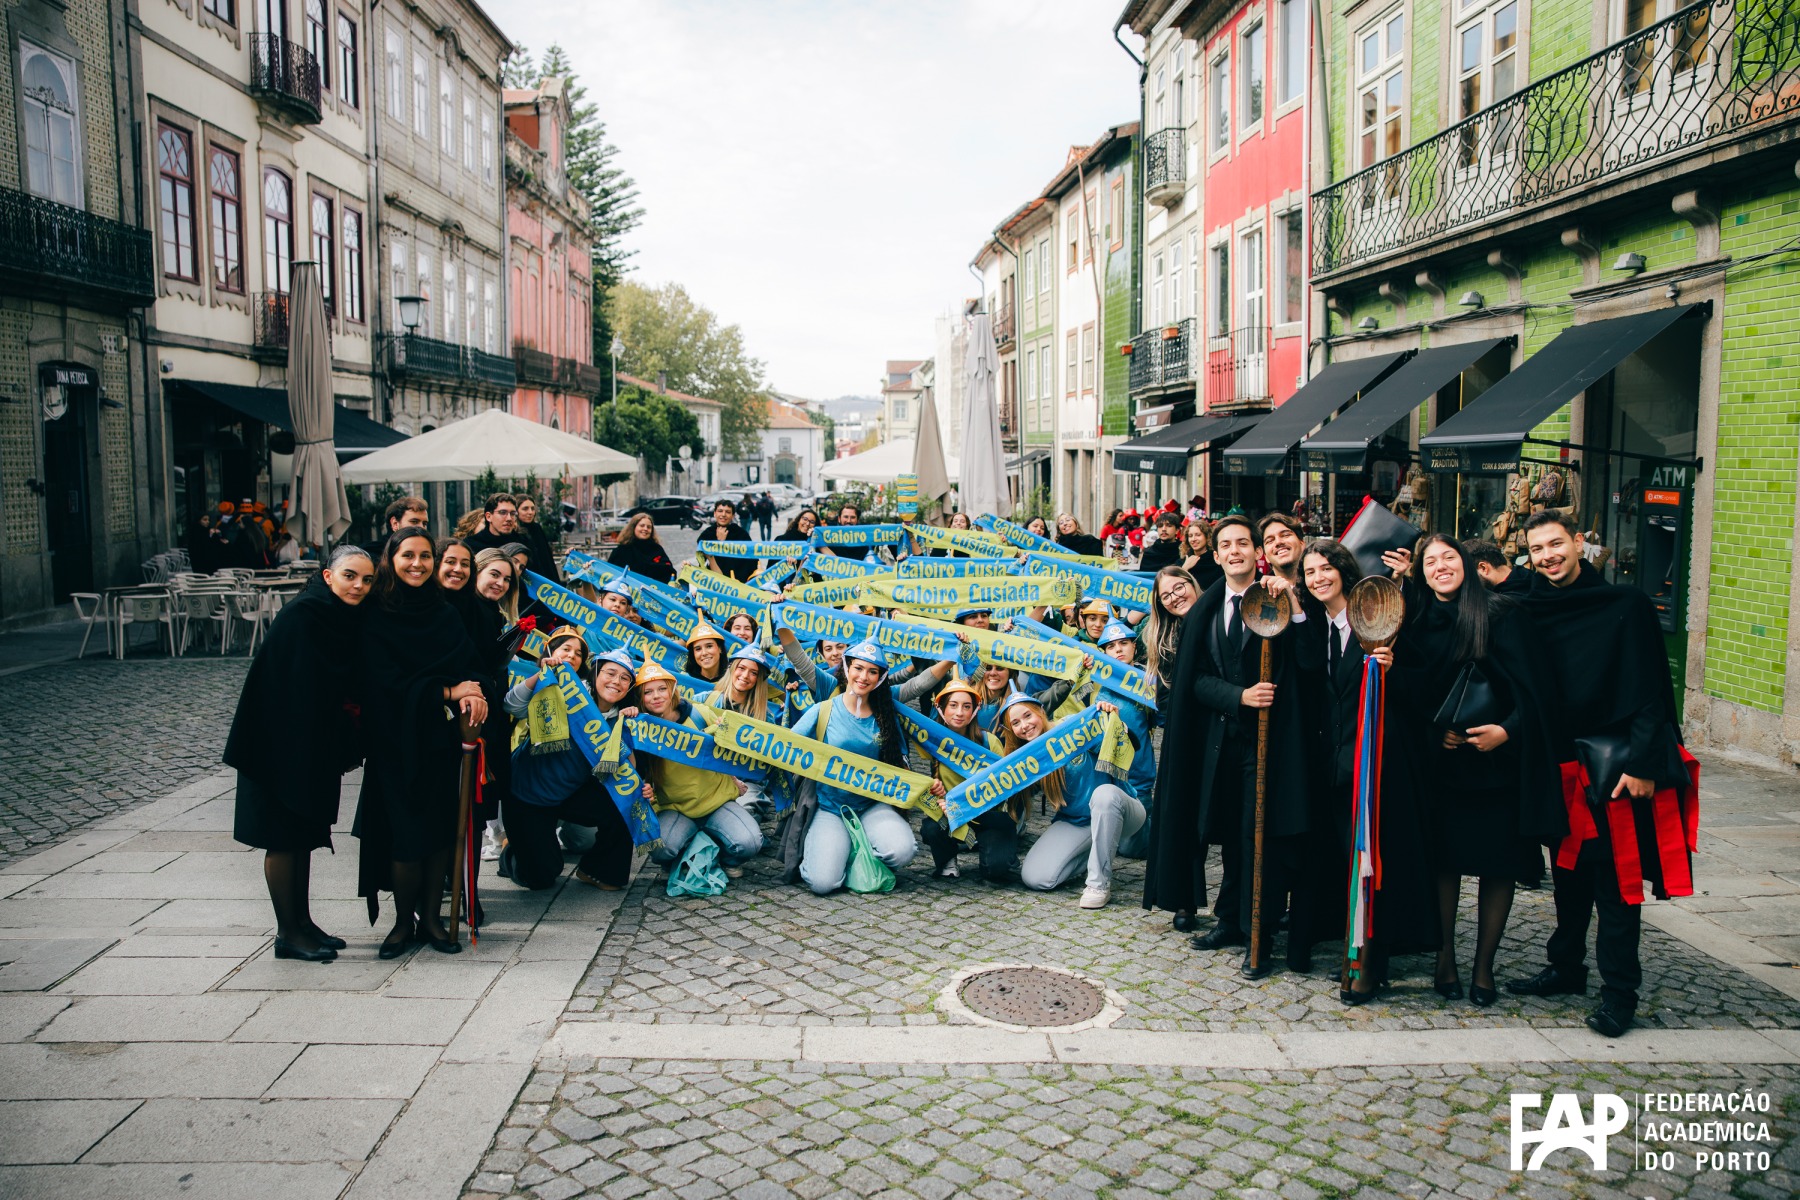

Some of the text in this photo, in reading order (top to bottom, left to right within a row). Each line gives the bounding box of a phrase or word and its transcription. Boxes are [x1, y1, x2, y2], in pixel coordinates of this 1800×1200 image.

[1431, 459, 1458, 468] TRADITION
[1651, 467, 1685, 487] ATM
[823, 530, 867, 544] Caloiro
[993, 518, 1034, 547] Caloiro
[702, 540, 803, 557] Caloiro Lusíada
[814, 555, 866, 577] Caloiro
[899, 560, 956, 577] Caloiro
[691, 569, 739, 598] Caloiro
[892, 584, 958, 604] Caloiro
[969, 581, 1040, 603] Lusíada
[1100, 575, 1153, 604] Lusía
[536, 583, 597, 625] Caloiro
[601, 616, 668, 662] Lusíada
[782, 606, 854, 639] Caloiro
[991, 639, 1067, 673] Lusíada
[735, 723, 911, 802] Caloiro Lusíada
[965, 756, 1040, 809] Caloiro
